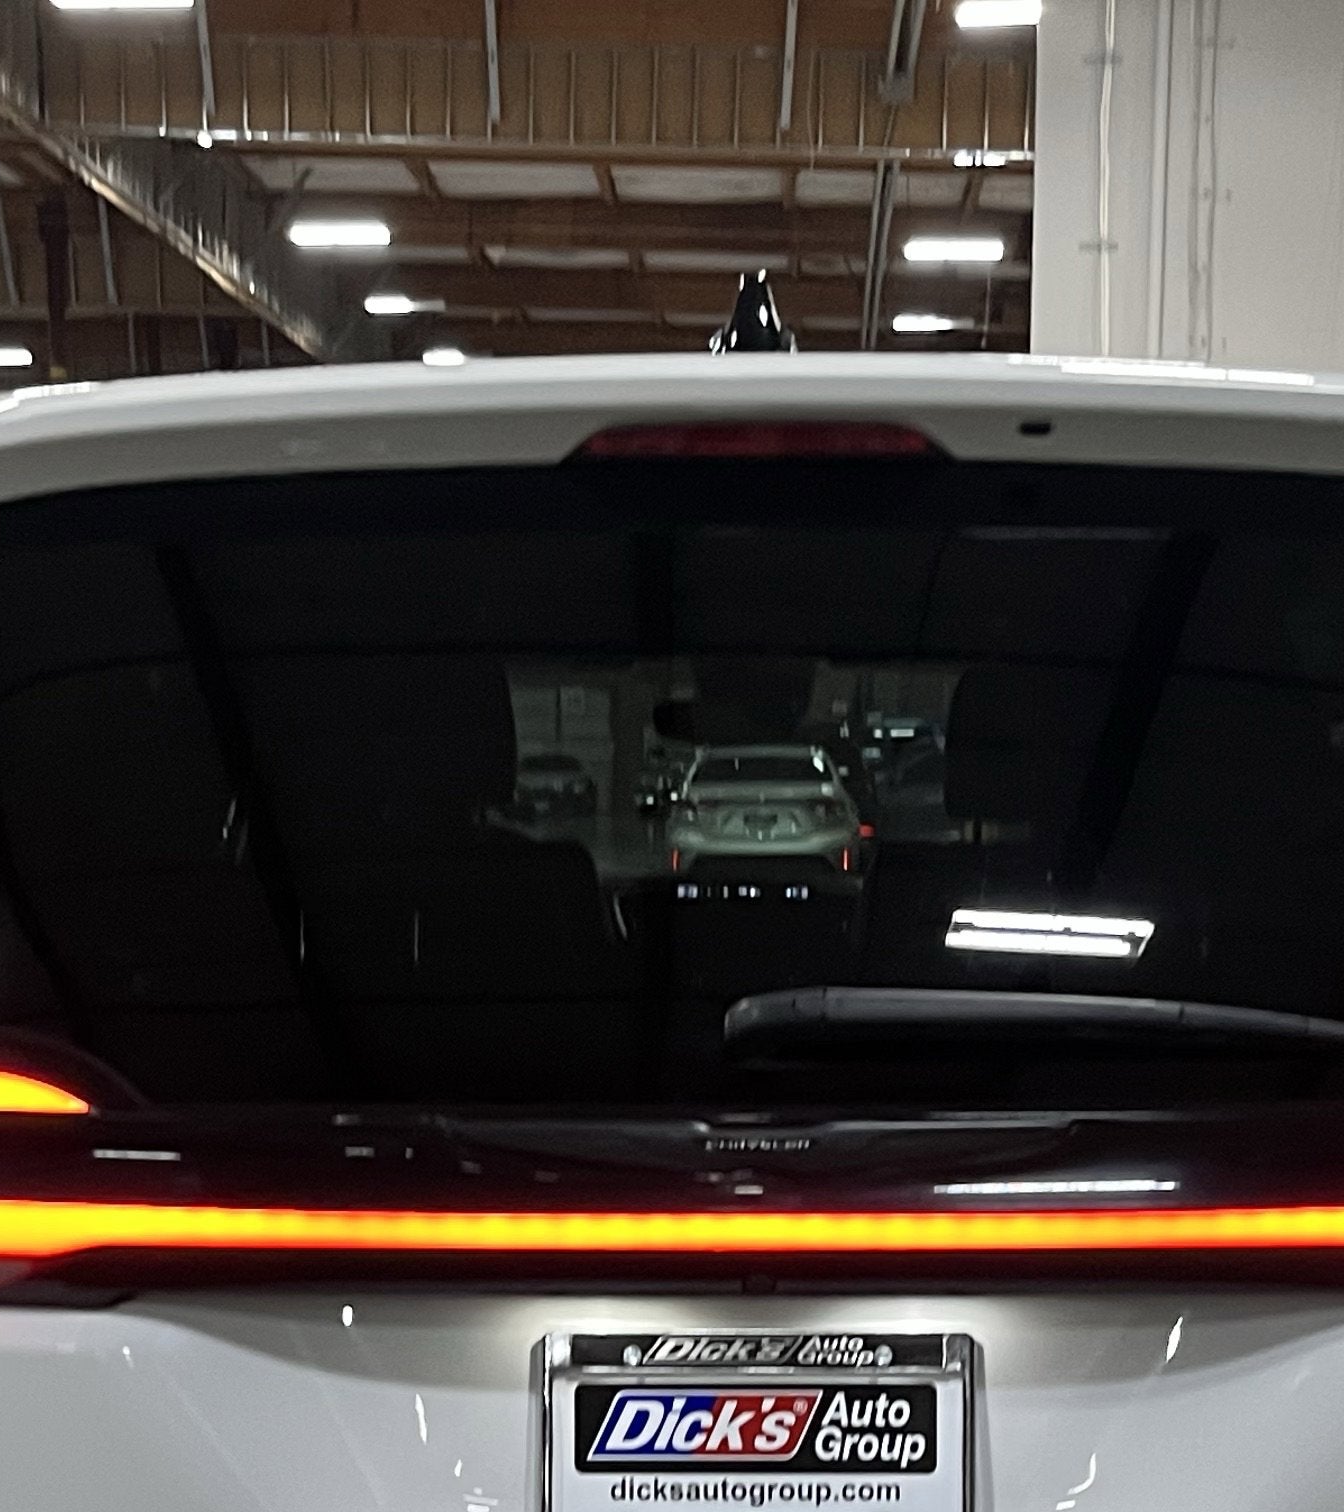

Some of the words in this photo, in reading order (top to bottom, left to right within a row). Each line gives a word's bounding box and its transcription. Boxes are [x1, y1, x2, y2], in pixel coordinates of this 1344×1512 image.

[797, 1351, 874, 1367] Group
[798, 1336, 864, 1351] Auto
[605, 1396, 797, 1452] Dick's
[821, 1393, 911, 1428] Auto
[814, 1429, 926, 1468] Group
[610, 1477, 901, 1507] dicksautogroup.com
